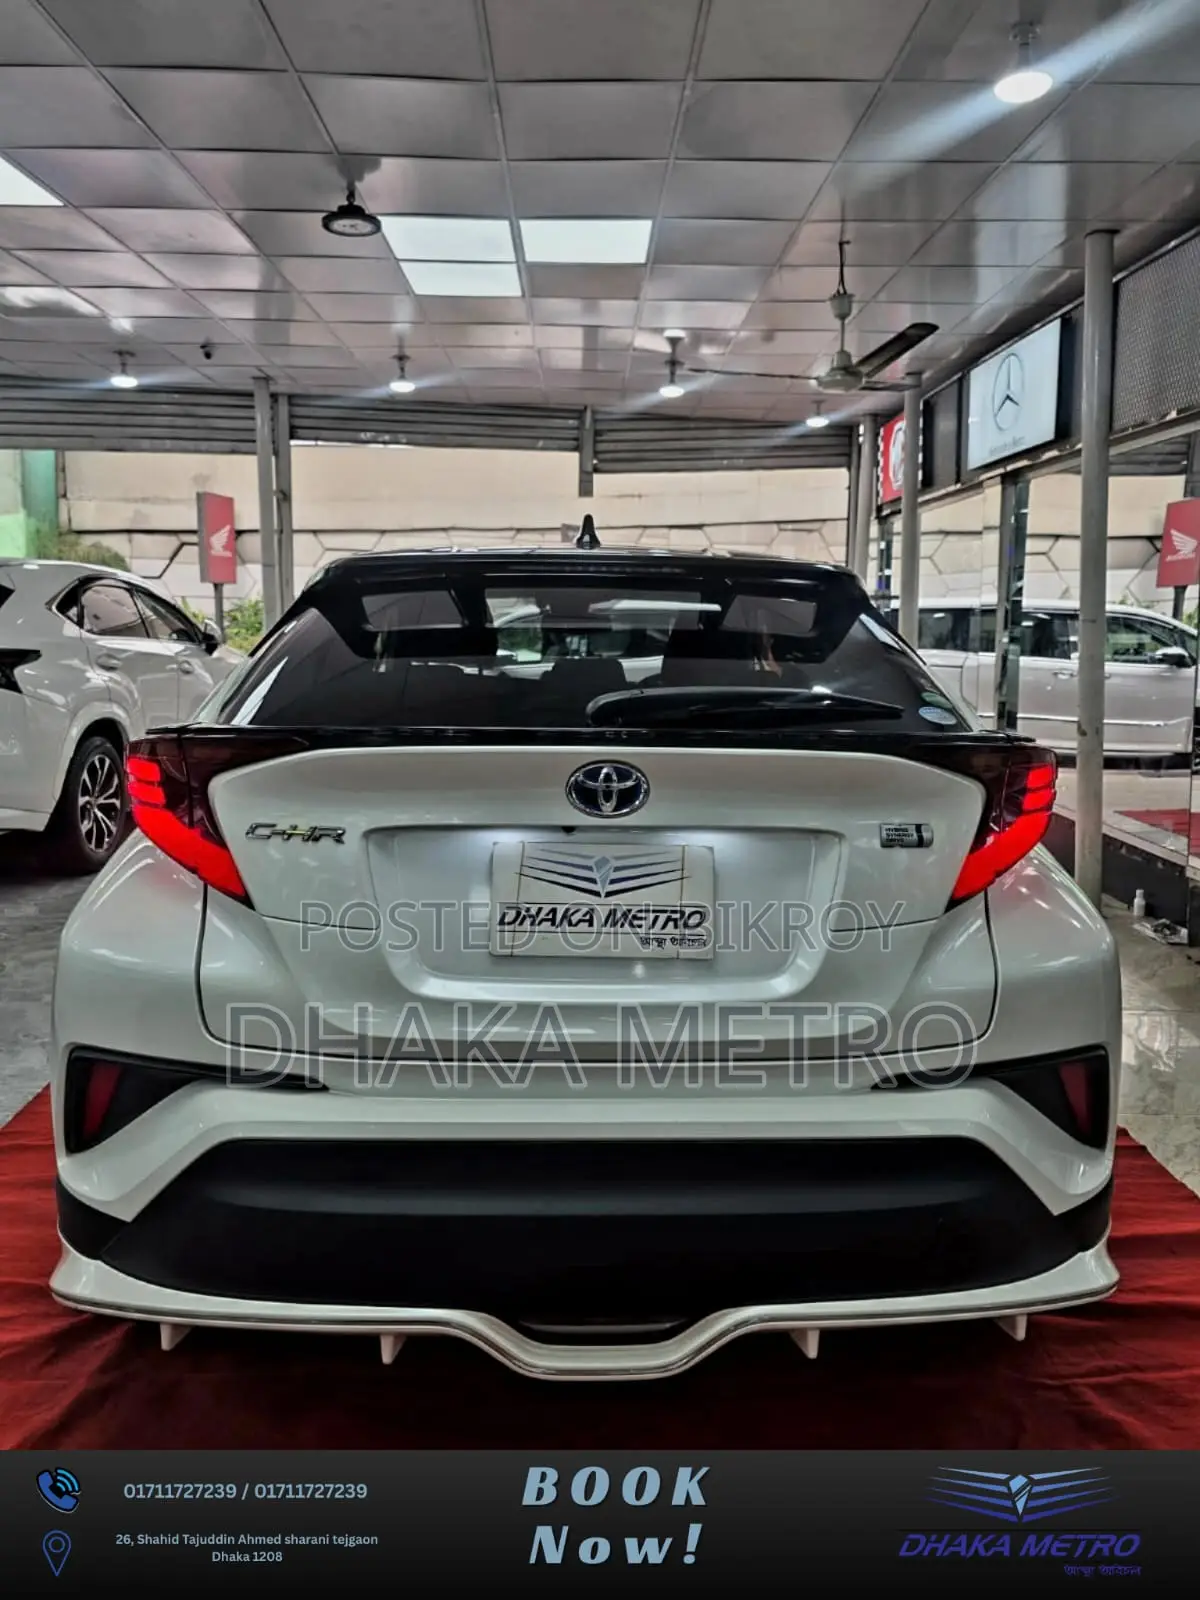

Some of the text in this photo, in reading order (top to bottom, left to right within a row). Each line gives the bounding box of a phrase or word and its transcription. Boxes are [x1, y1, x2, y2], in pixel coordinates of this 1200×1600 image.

[245, 822, 346, 844] C-HR
[498, 905, 706, 930] DHAKA METRO
